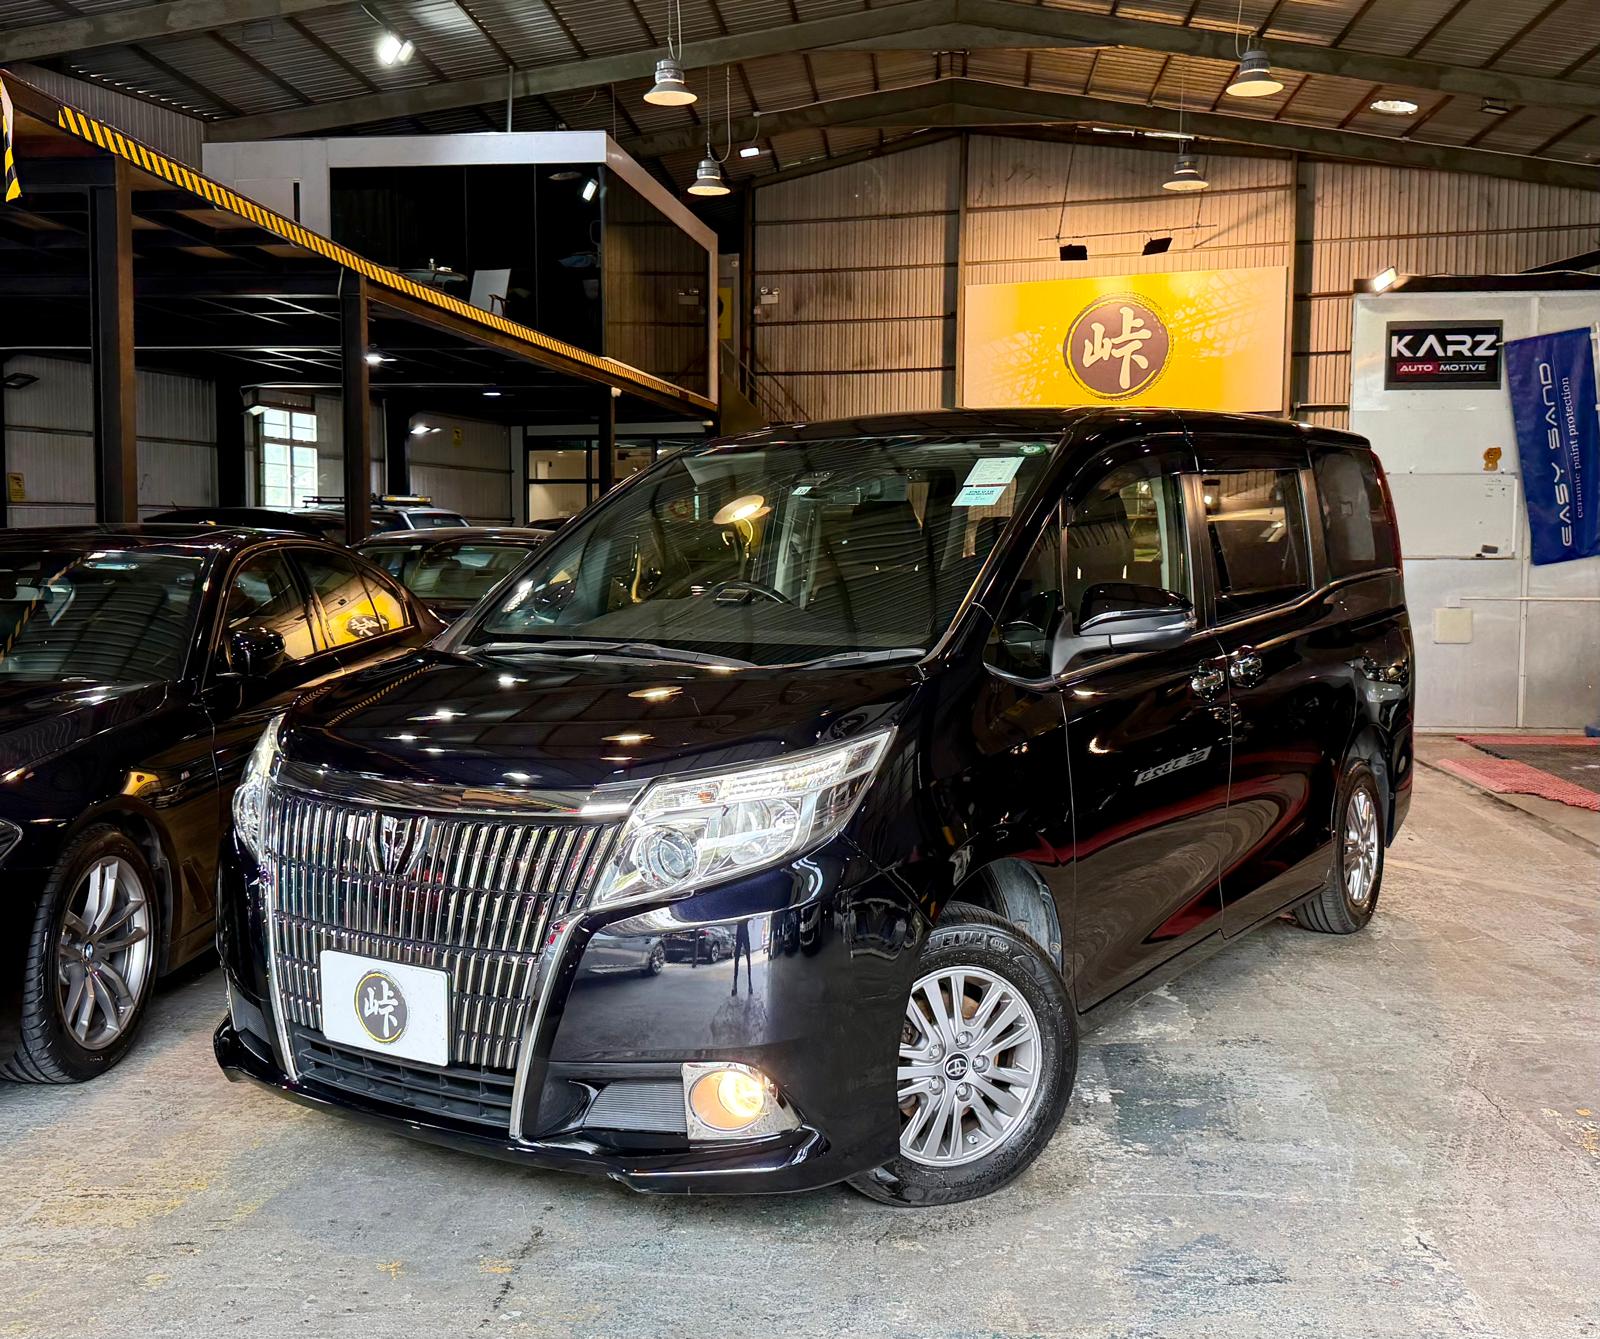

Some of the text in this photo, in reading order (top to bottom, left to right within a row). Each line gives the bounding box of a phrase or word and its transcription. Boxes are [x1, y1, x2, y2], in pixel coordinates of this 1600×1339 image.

[1082, 306, 1152, 390] 峠
[1391, 334, 1497, 357] KARZ
[1400, 363, 1487, 372] AUTO MOTIVE
[1539, 363, 1573, 546] EASY SAND
[1561, 377, 1584, 518] ceramic paint protection
[364, 980, 399, 1038] 峠
